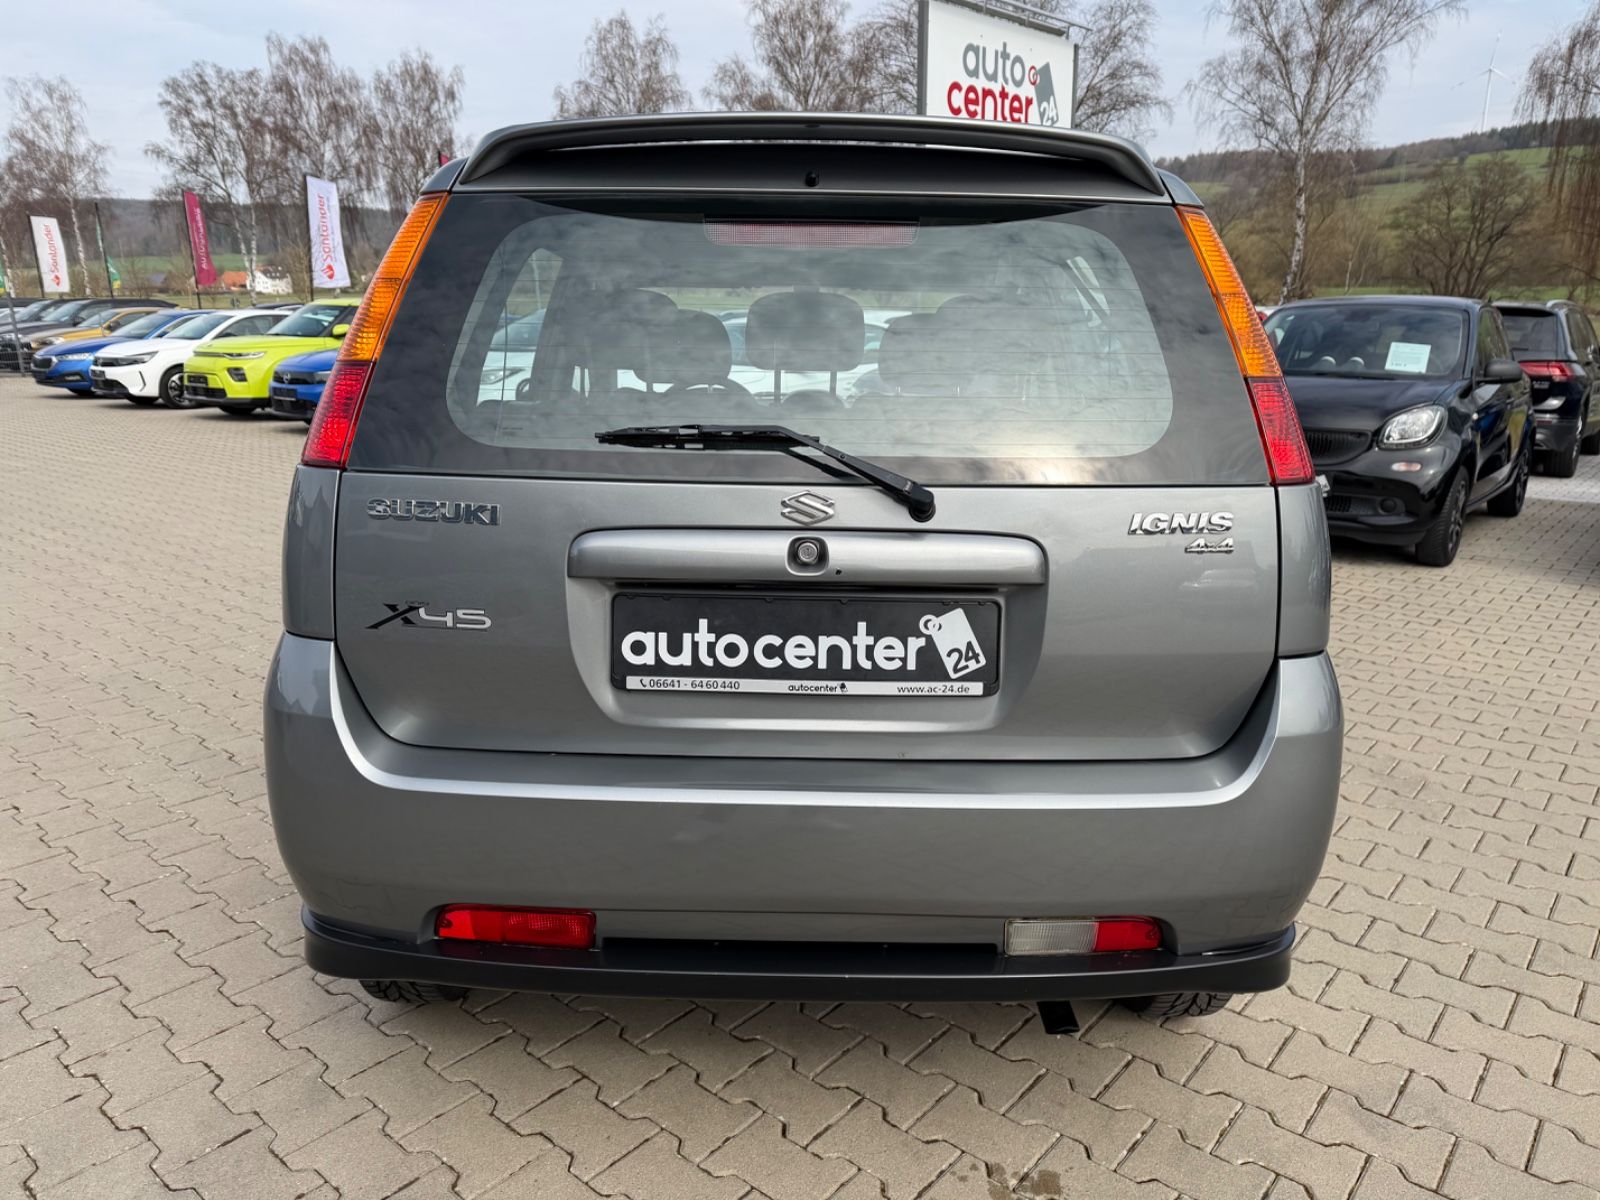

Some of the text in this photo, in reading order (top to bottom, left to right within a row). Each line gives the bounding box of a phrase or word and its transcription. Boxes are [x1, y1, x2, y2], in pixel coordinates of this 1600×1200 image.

[963, 42, 1025, 88] auto
[947, 81, 1033, 124] center
[44, 223, 59, 273] Santander
[317, 193, 333, 262] Santander
[367, 498, 501, 526] SUZUKI
[1128, 511, 1234, 535] IGNIS
[621, 618, 981, 674] autocenter 24
[788, 683, 837, 693] autocenter
[897, 684, 970, 694] www.ac-24.de
